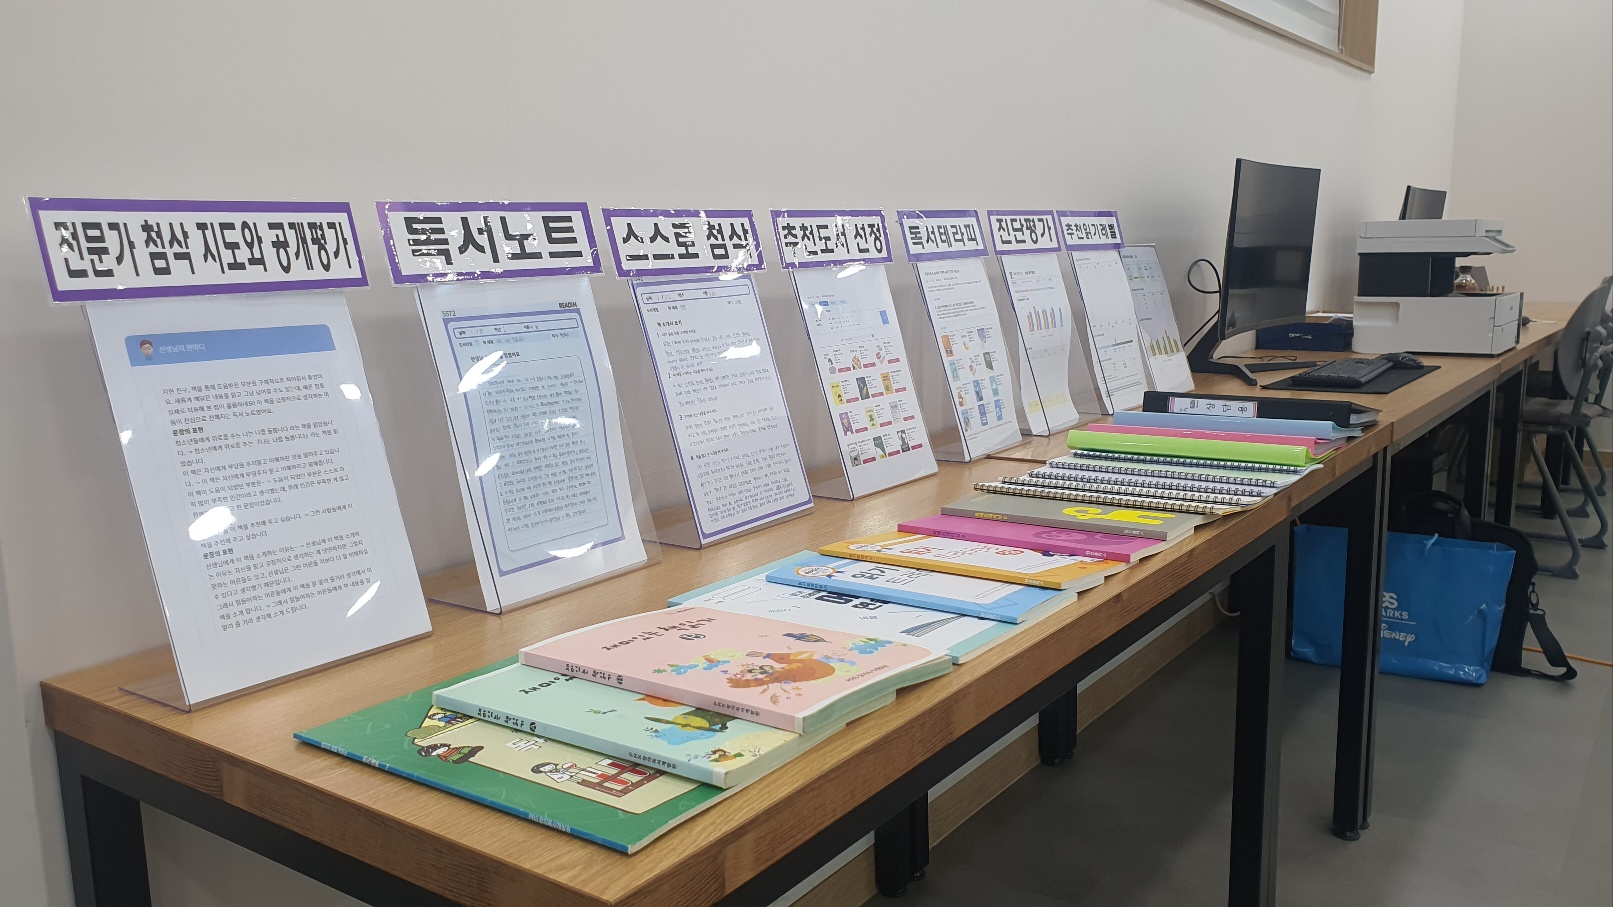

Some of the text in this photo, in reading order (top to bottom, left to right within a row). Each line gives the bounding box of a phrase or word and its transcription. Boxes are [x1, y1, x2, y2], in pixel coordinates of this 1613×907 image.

[403, 215, 584, 266] 독서노트
[622, 221, 753, 261] 스스로 첨삭
[782, 222, 884, 257] 추천도서 선정
[908, 223, 979, 250] 독서테라피
[996, 217, 1053, 245] 진단평가
[54, 219, 352, 279] 전문가 첨삭 지도와 공개평가
[851, 565, 900, 581] 읽기
[1382, 608, 1409, 620] ARKS
[601, 617, 716, 651] 재미있는 책읽기
[518, 674, 577, 695] 재미있
